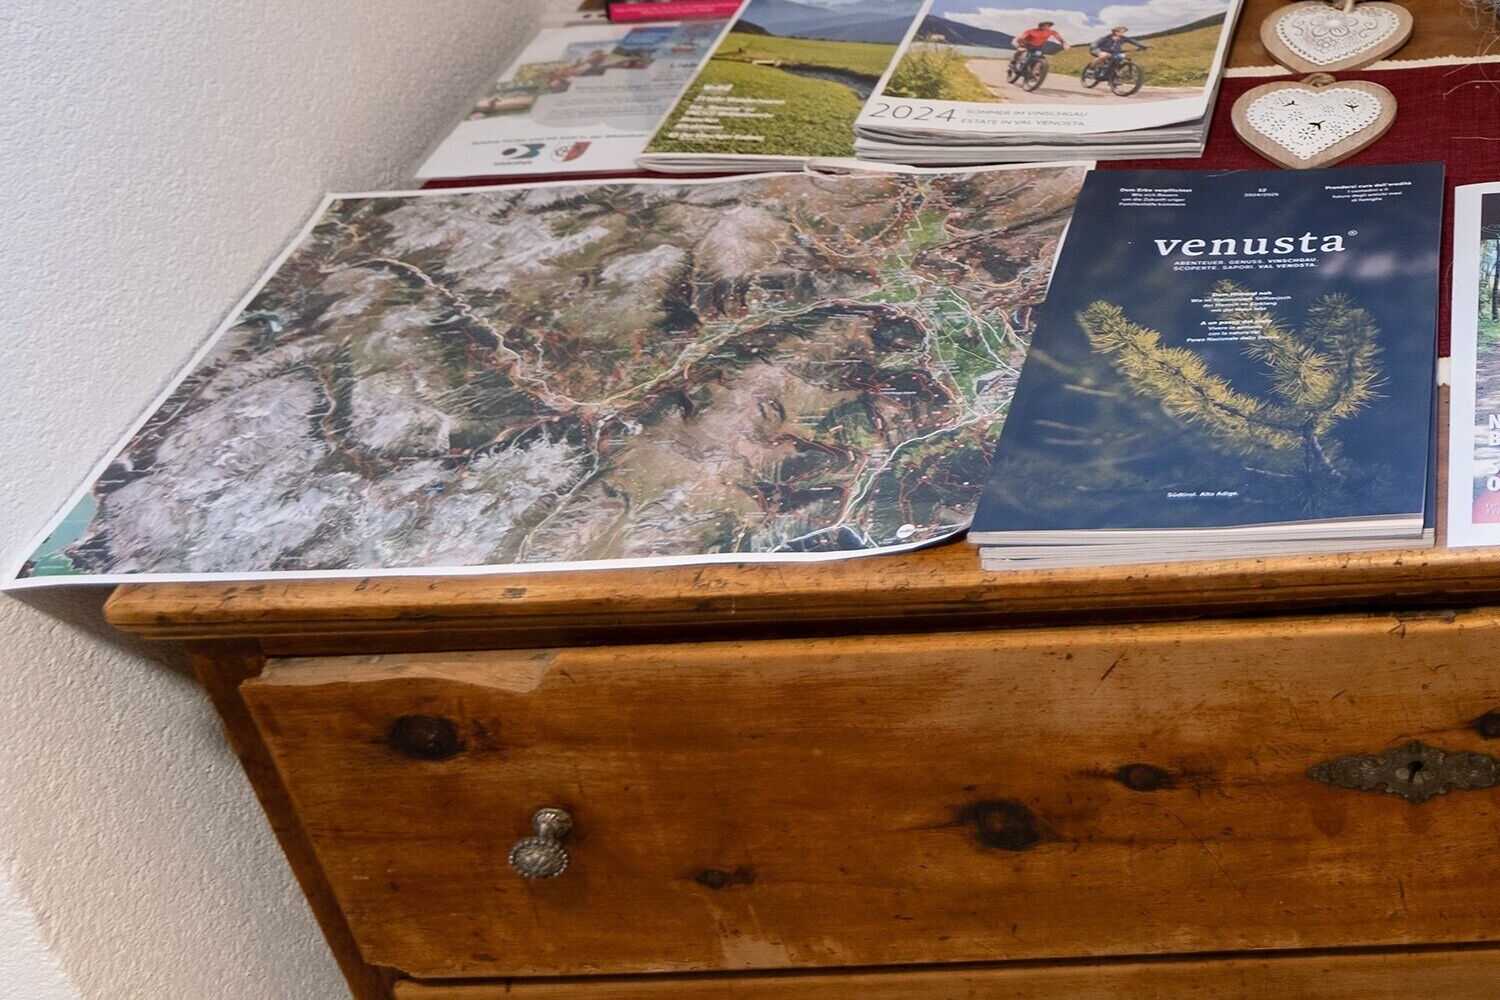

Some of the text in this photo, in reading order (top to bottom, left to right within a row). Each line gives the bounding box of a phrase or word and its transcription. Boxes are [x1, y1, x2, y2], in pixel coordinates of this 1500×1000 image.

[869, 102, 957, 122] 2024
[966, 108, 1010, 117] SOMMER
[961, 117, 998, 125] ESTATE
